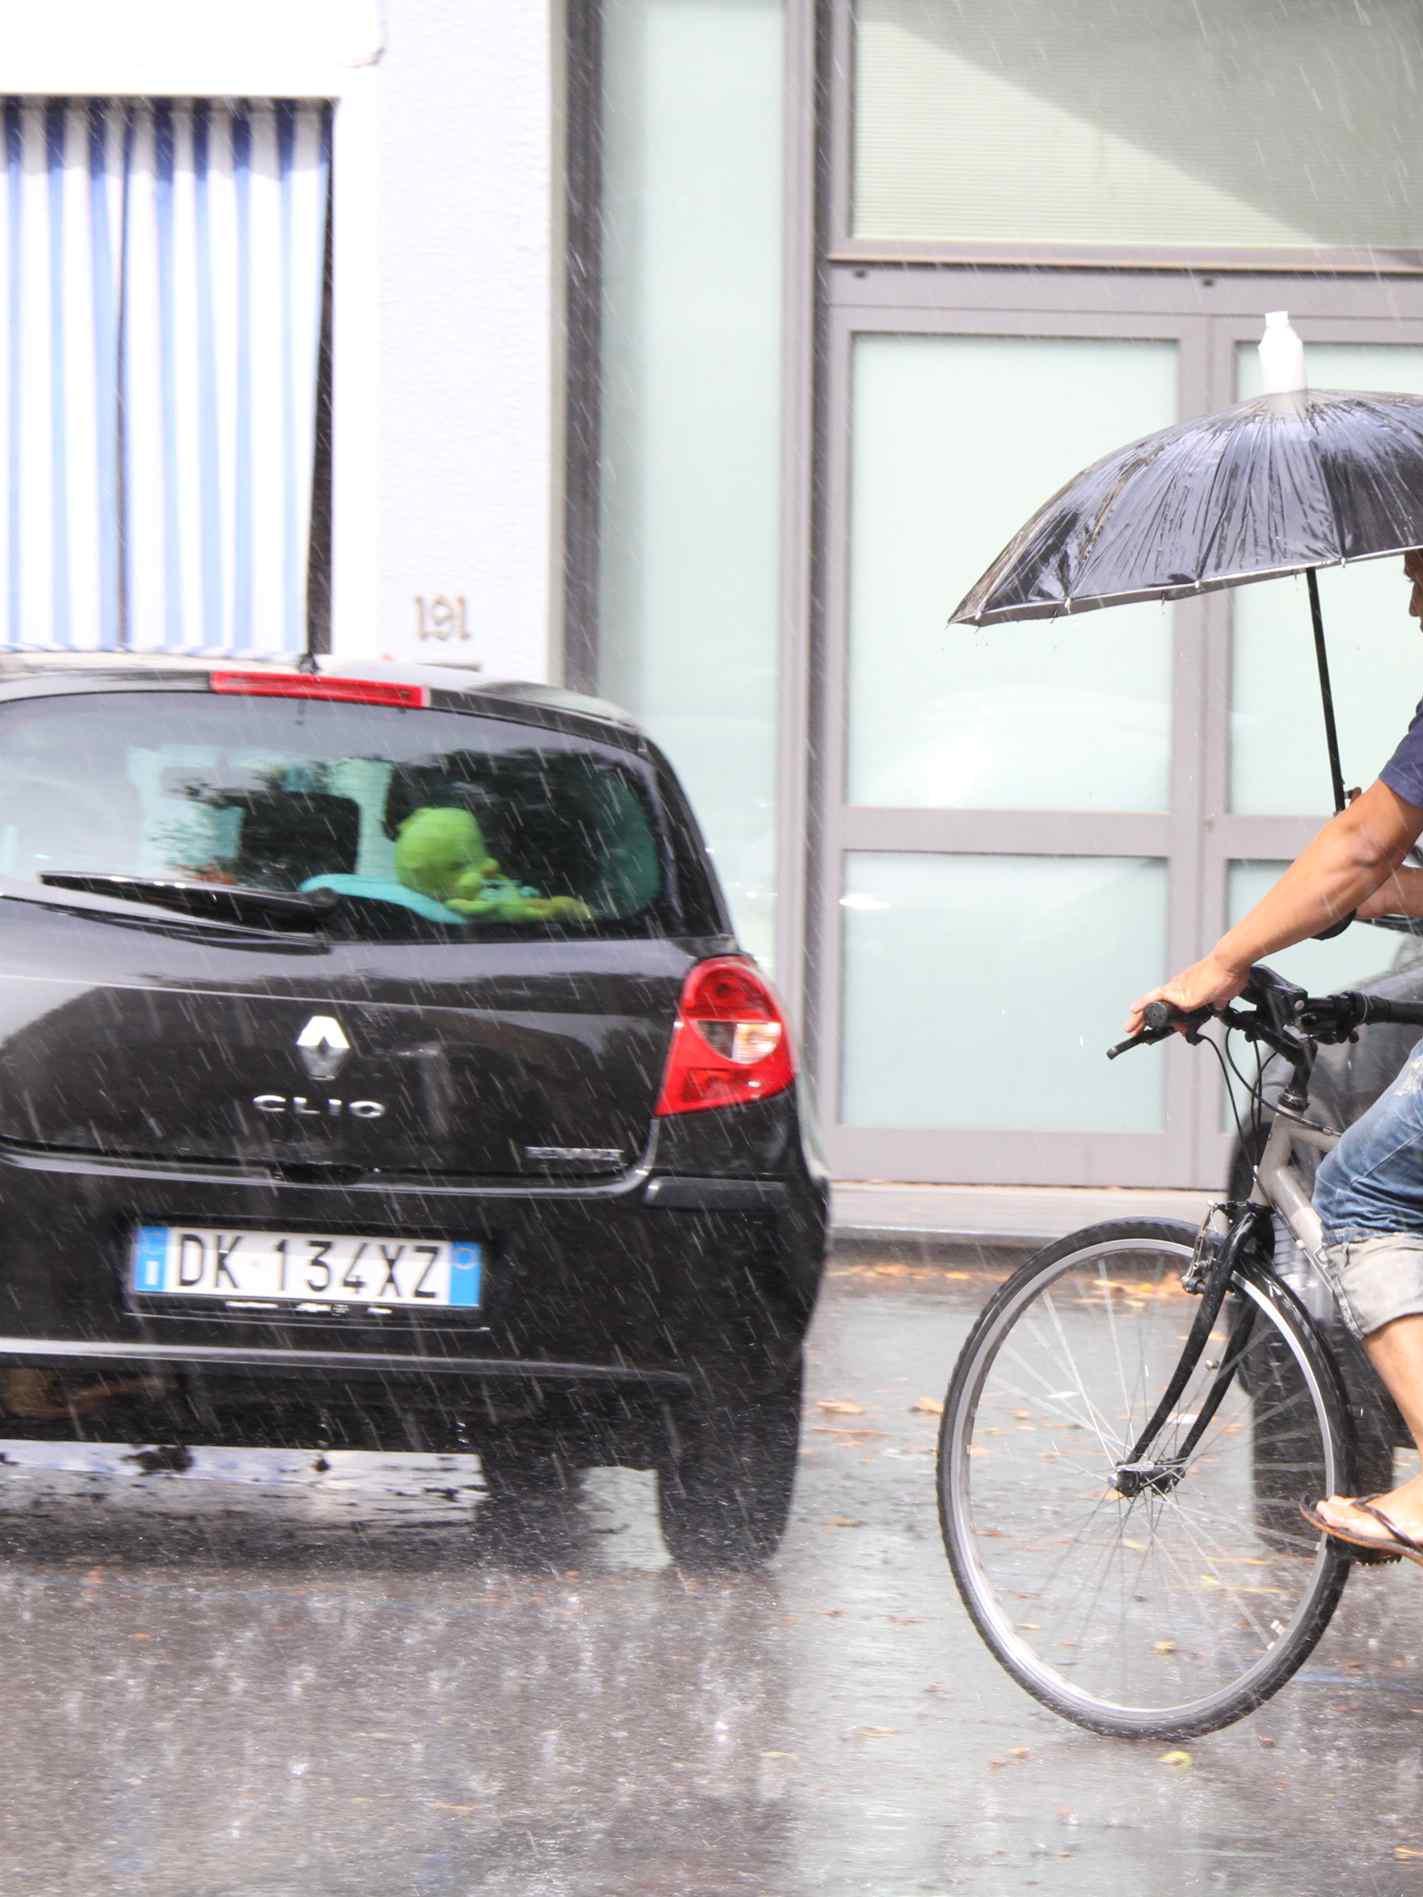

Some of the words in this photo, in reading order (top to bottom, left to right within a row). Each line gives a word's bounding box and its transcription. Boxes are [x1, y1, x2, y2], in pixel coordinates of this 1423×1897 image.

[414, 593, 471, 642] 191
[253, 1094, 385, 1118] CLIO
[178, 1233, 243, 1289] DK
[271, 1239, 441, 1299] 134XZ
